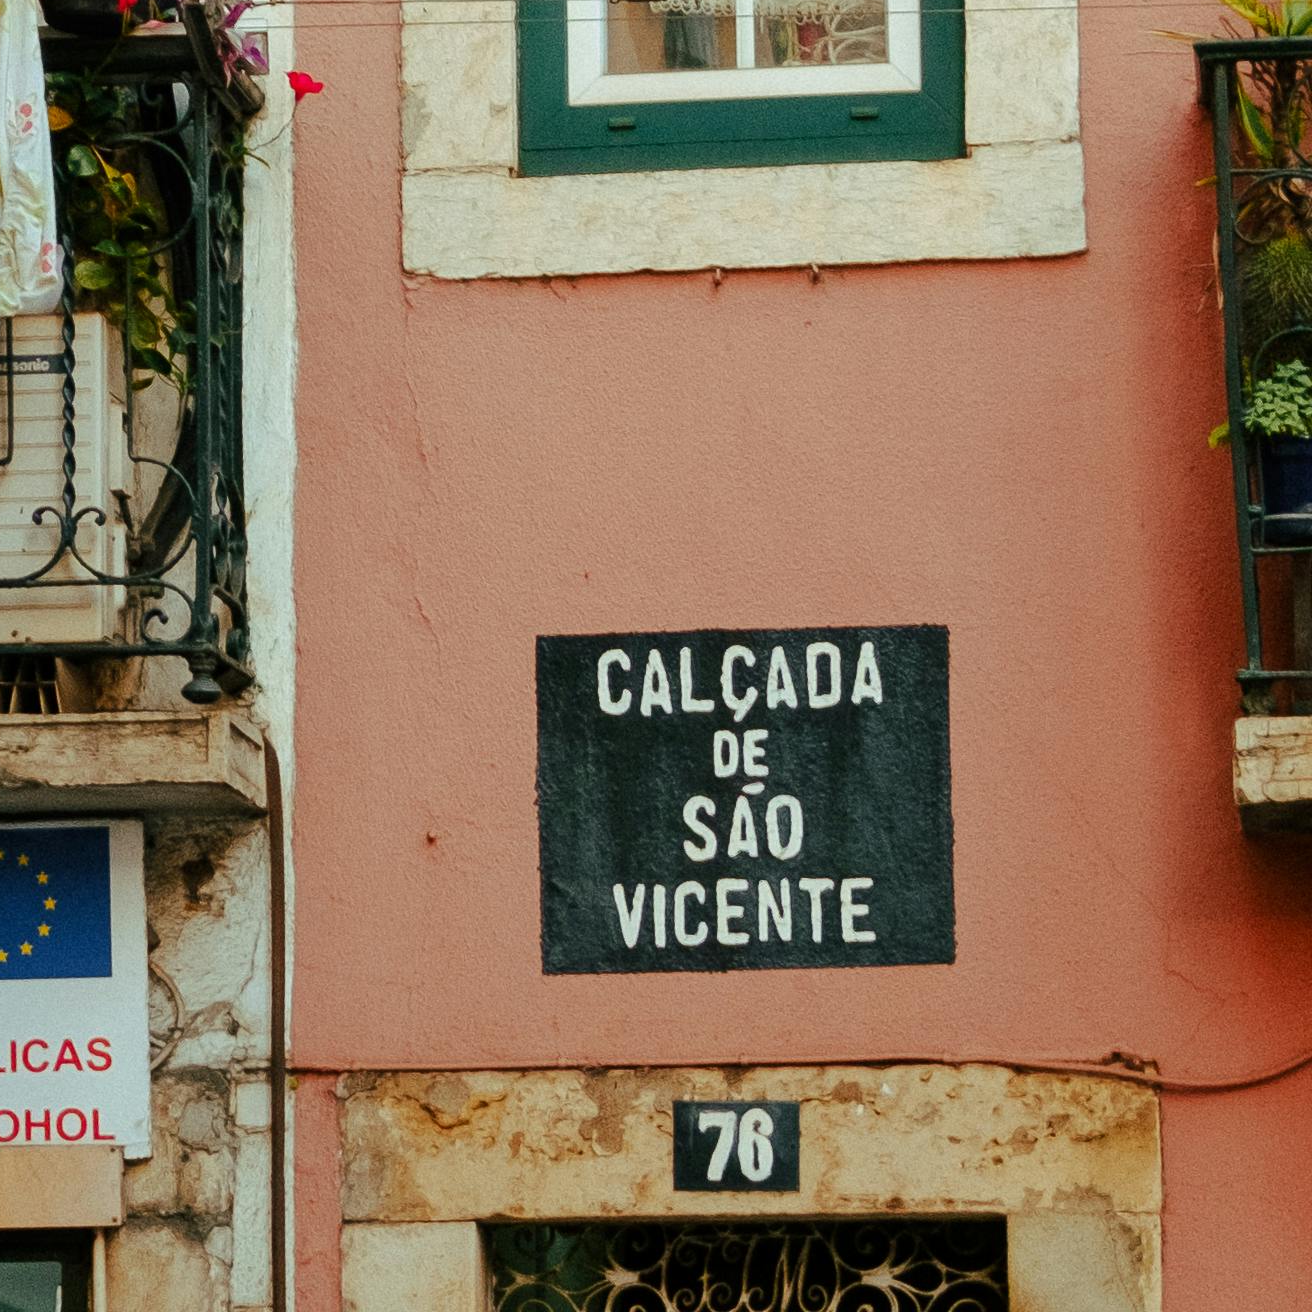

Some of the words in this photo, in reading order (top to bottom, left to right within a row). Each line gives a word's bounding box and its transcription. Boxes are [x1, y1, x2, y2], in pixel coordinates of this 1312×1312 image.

[596, 641, 884, 723] CALÇADA
[713, 729, 769, 778] DE
[682, 781, 804, 862] SÃO
[612, 877, 877, 949] VICENTE
[698, 1107, 774, 1182] 76
